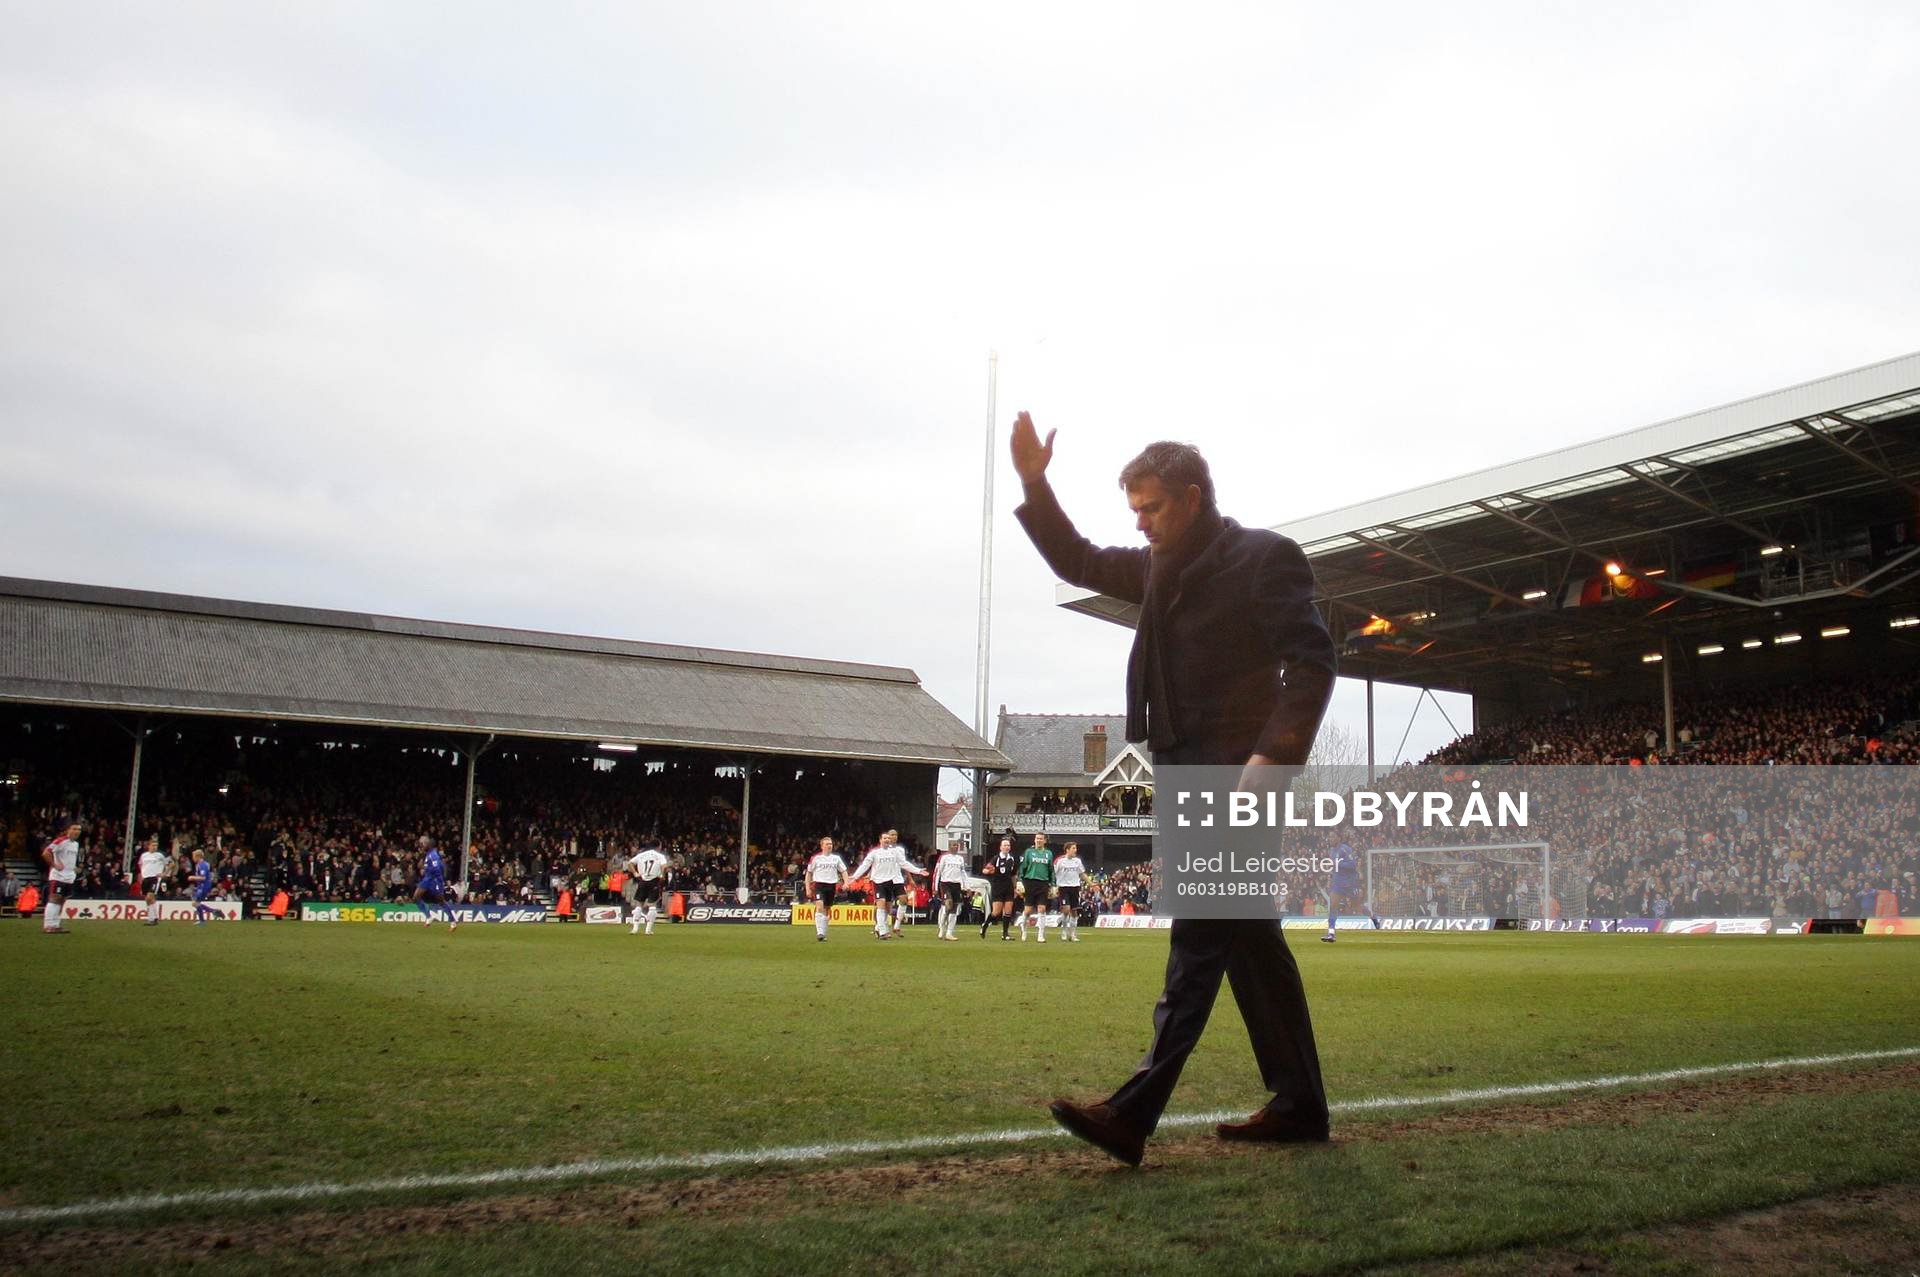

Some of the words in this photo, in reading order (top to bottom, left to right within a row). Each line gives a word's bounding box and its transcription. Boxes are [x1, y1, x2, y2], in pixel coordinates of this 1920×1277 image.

[644, 860, 654, 876] 17
[96, 904, 211, 921] 32Rel.com
[302, 907, 427, 921] bet365.com
[429, 910, 487, 923] NIVEA
[500, 909, 546, 923] MEN
[712, 908, 792, 918] SKECHERS
[1381, 918, 1467, 930] BARCLAYS
